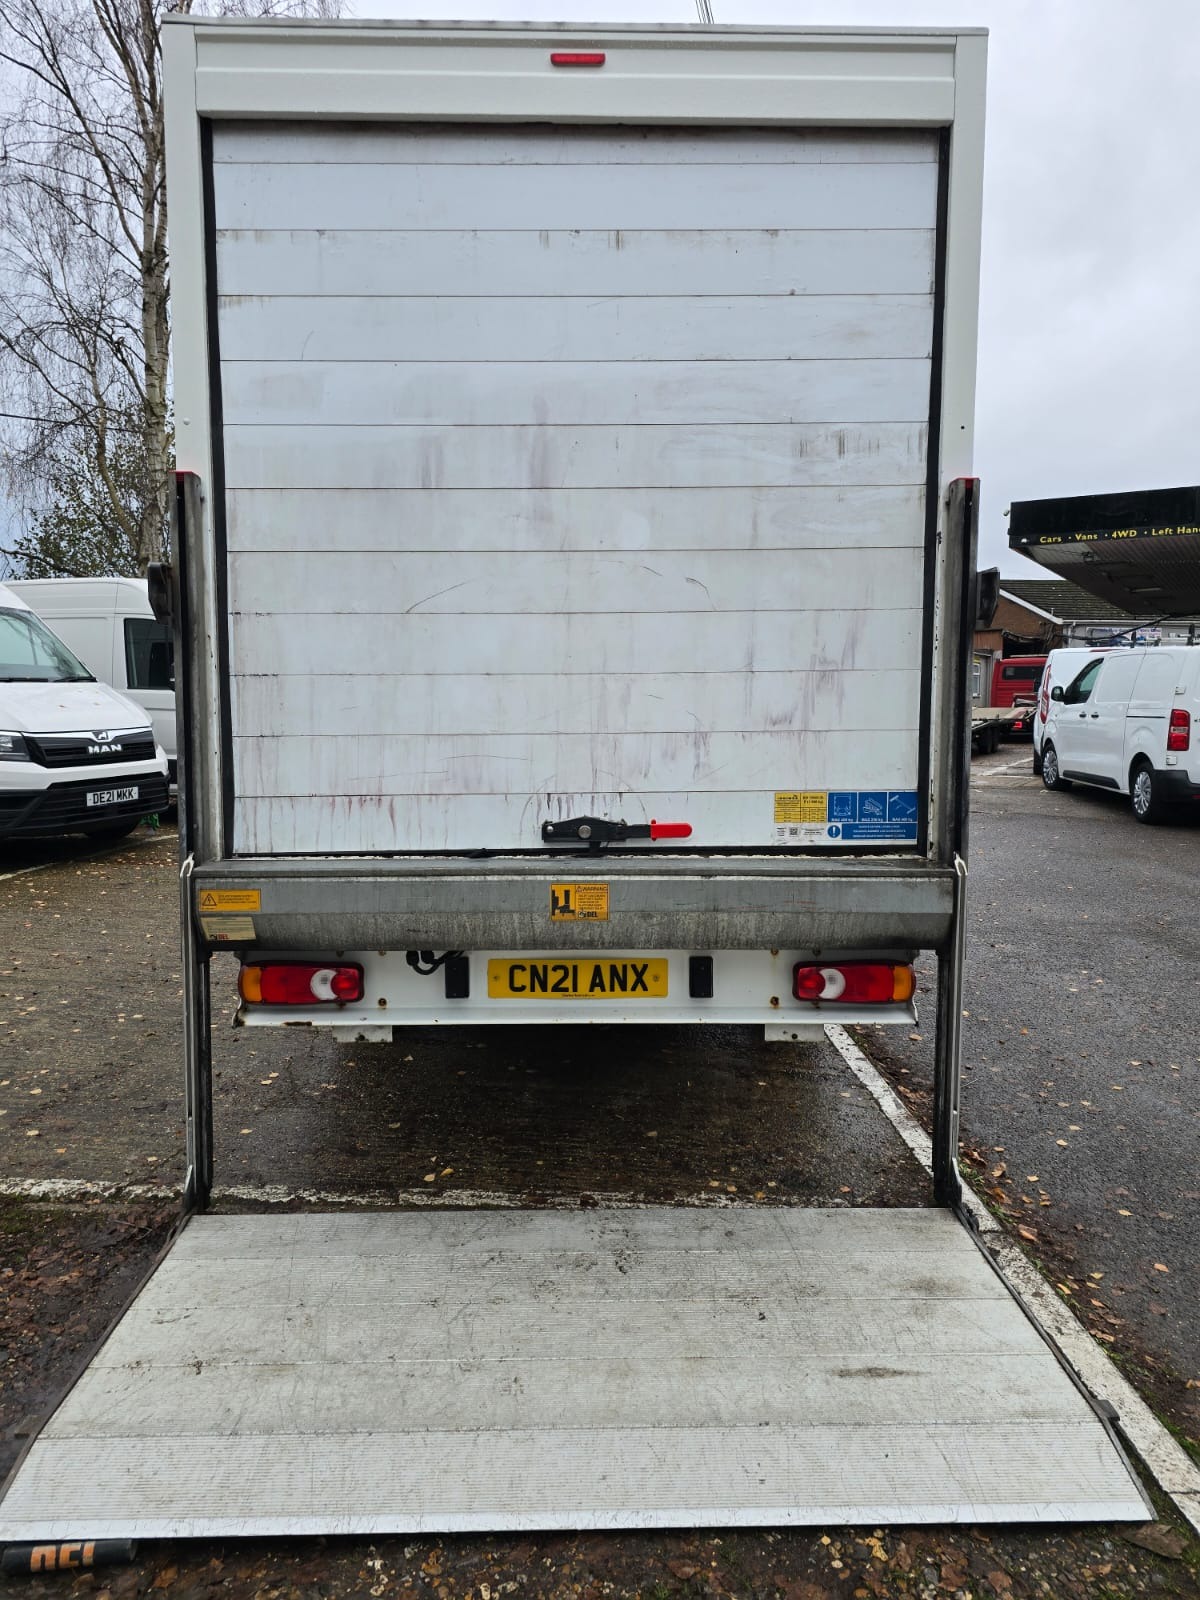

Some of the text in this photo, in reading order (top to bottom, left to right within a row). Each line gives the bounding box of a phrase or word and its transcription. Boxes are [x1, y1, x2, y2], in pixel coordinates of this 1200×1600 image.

[1039, 526, 1200, 544] Cars Vans 4WD Left Han
[88, 744, 122, 754] MAN
[93, 788, 134, 805] DE21 MKK
[509, 963, 649, 993] CN21 ANX
